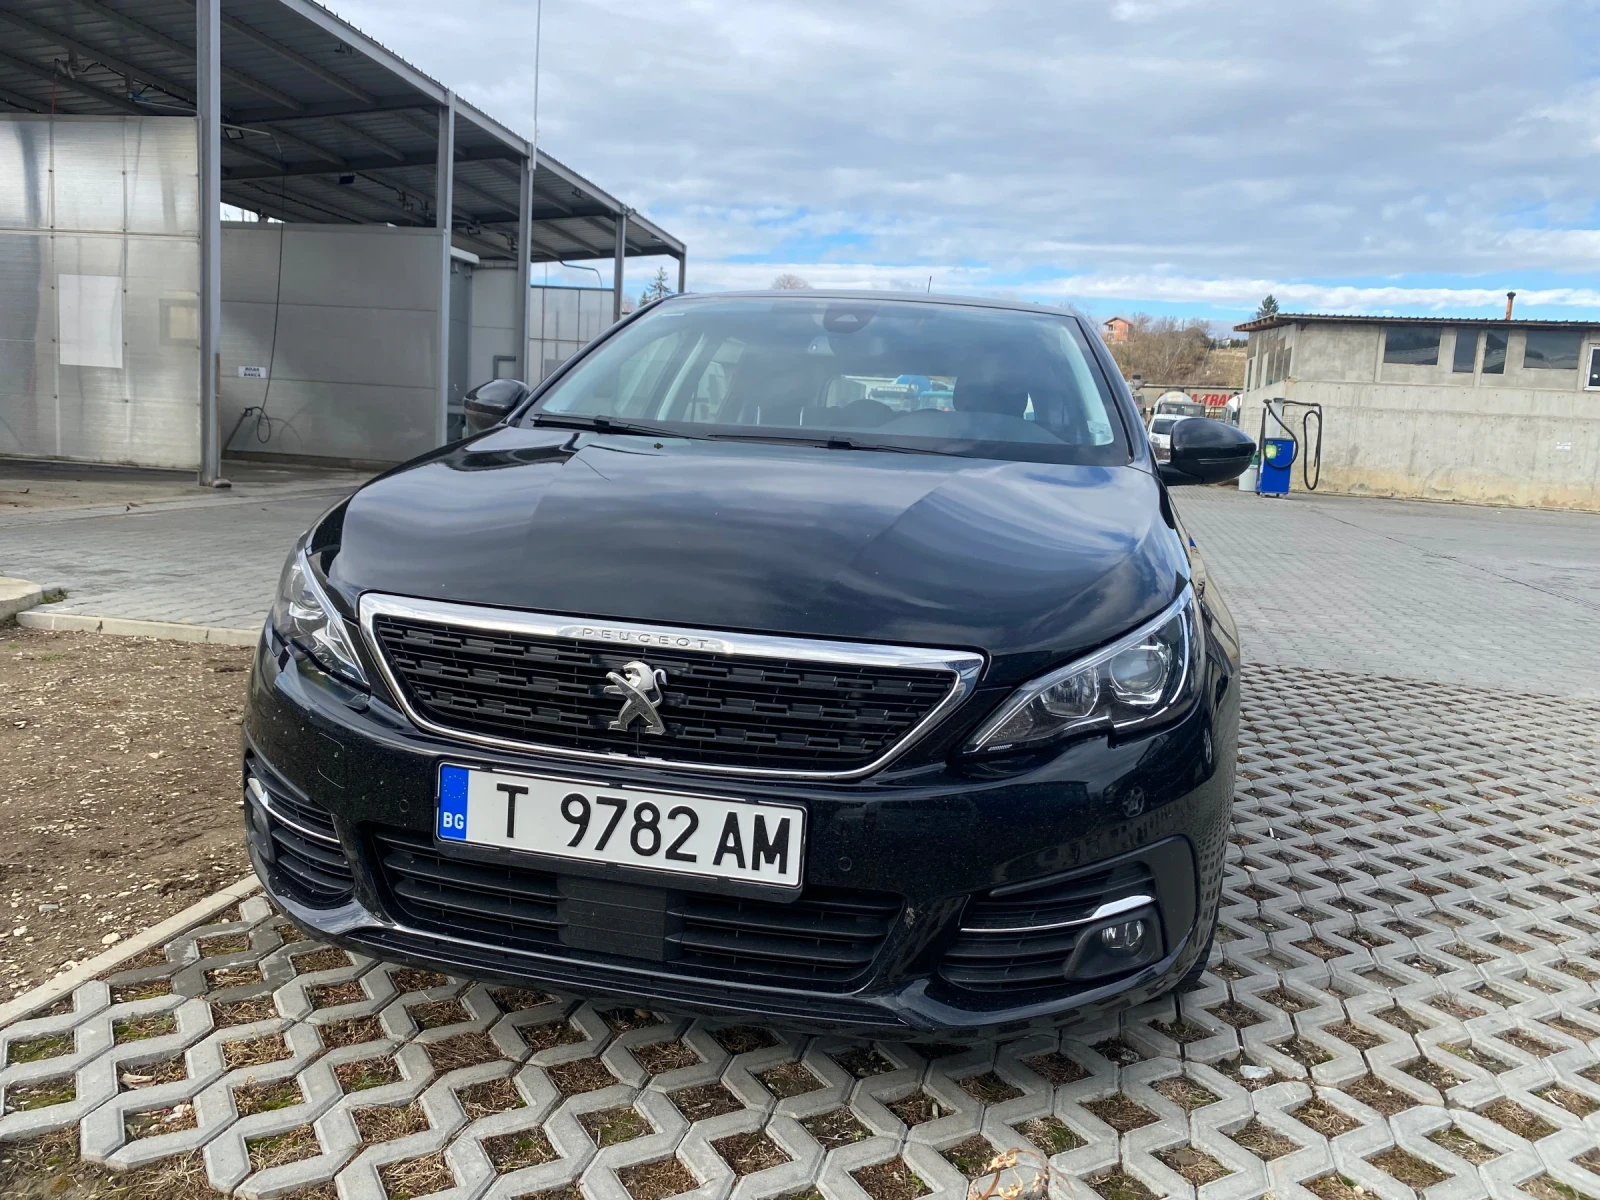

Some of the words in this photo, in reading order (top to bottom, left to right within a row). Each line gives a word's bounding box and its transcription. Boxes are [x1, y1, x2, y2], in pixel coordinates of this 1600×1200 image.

[582, 627, 709, 649] PEUGEOT
[443, 811, 465, 830] BG
[496, 781, 529, 839] T
[560, 792, 700, 864] 9782
[712, 810, 792, 875] AM
